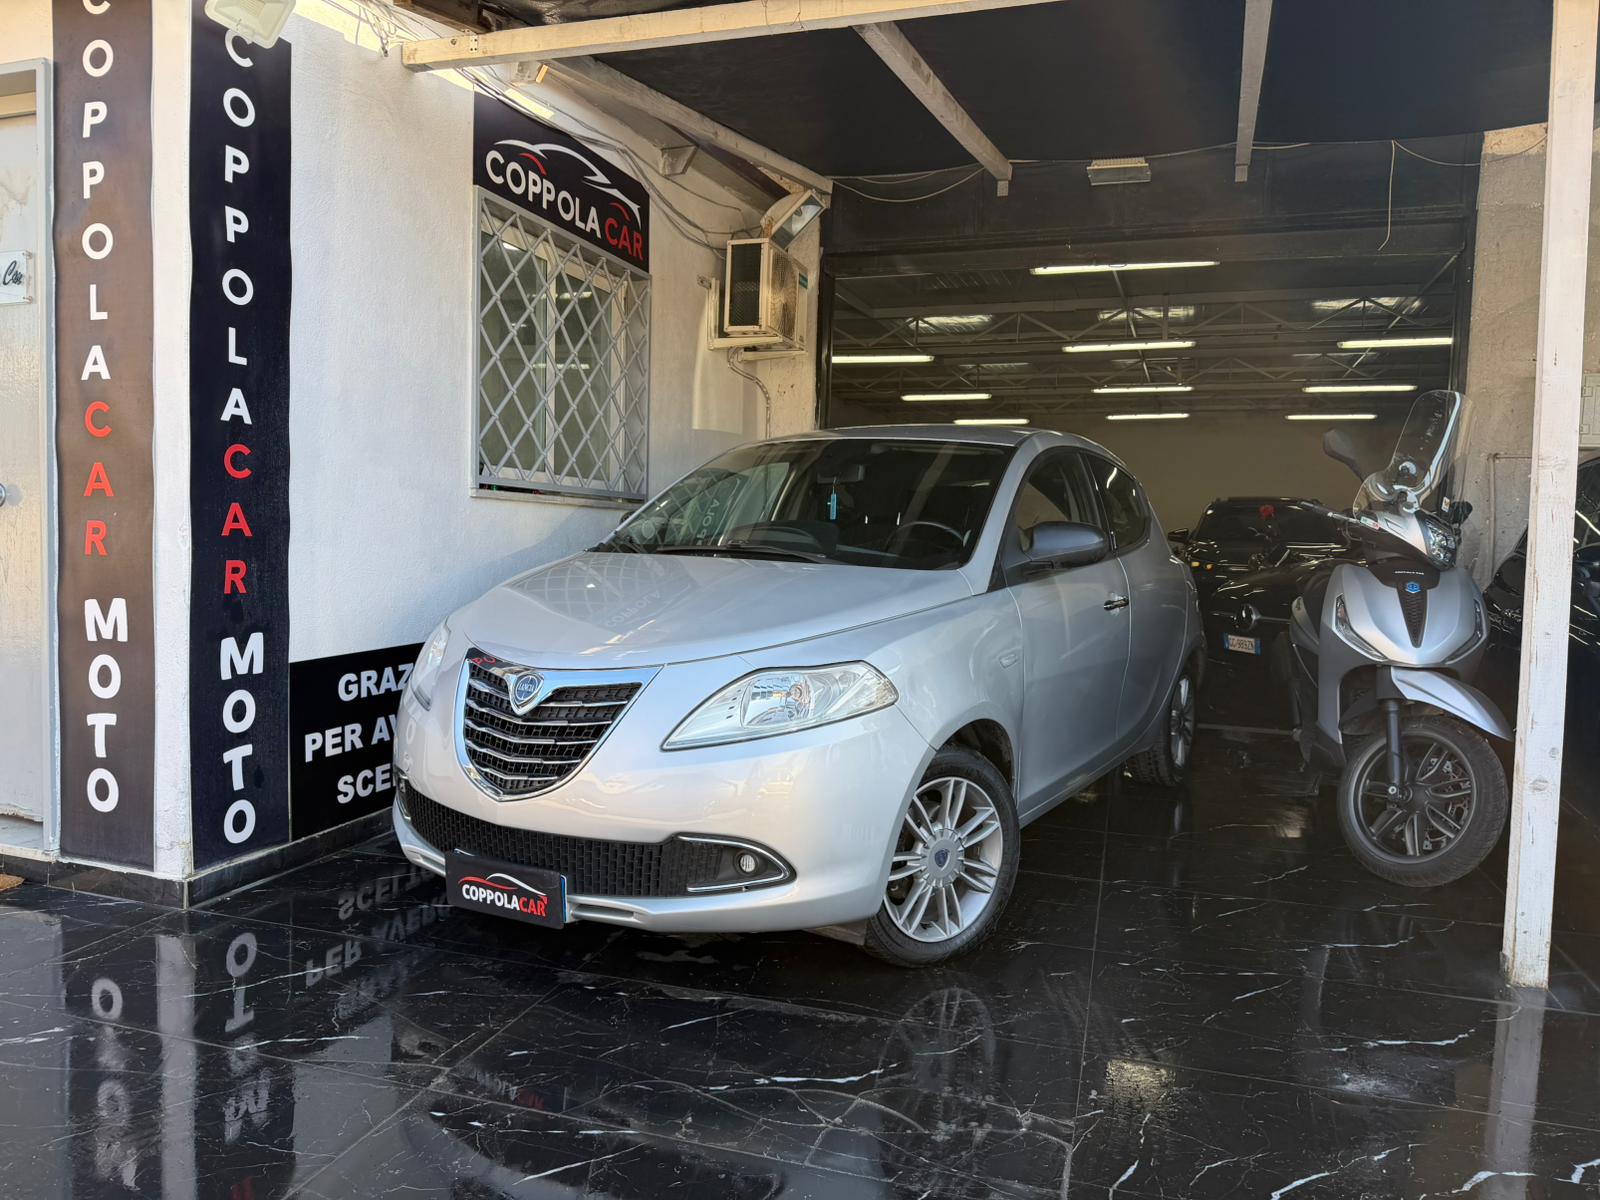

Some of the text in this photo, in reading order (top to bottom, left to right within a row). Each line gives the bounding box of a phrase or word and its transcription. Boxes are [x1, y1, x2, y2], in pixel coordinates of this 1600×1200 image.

[84, 597, 129, 813] MOTO
[220, 632, 265, 844] MOTO
[305, 723, 363, 763] PER
[337, 763, 397, 804] SCE
[462, 884, 548, 917] COPPOLACAR
